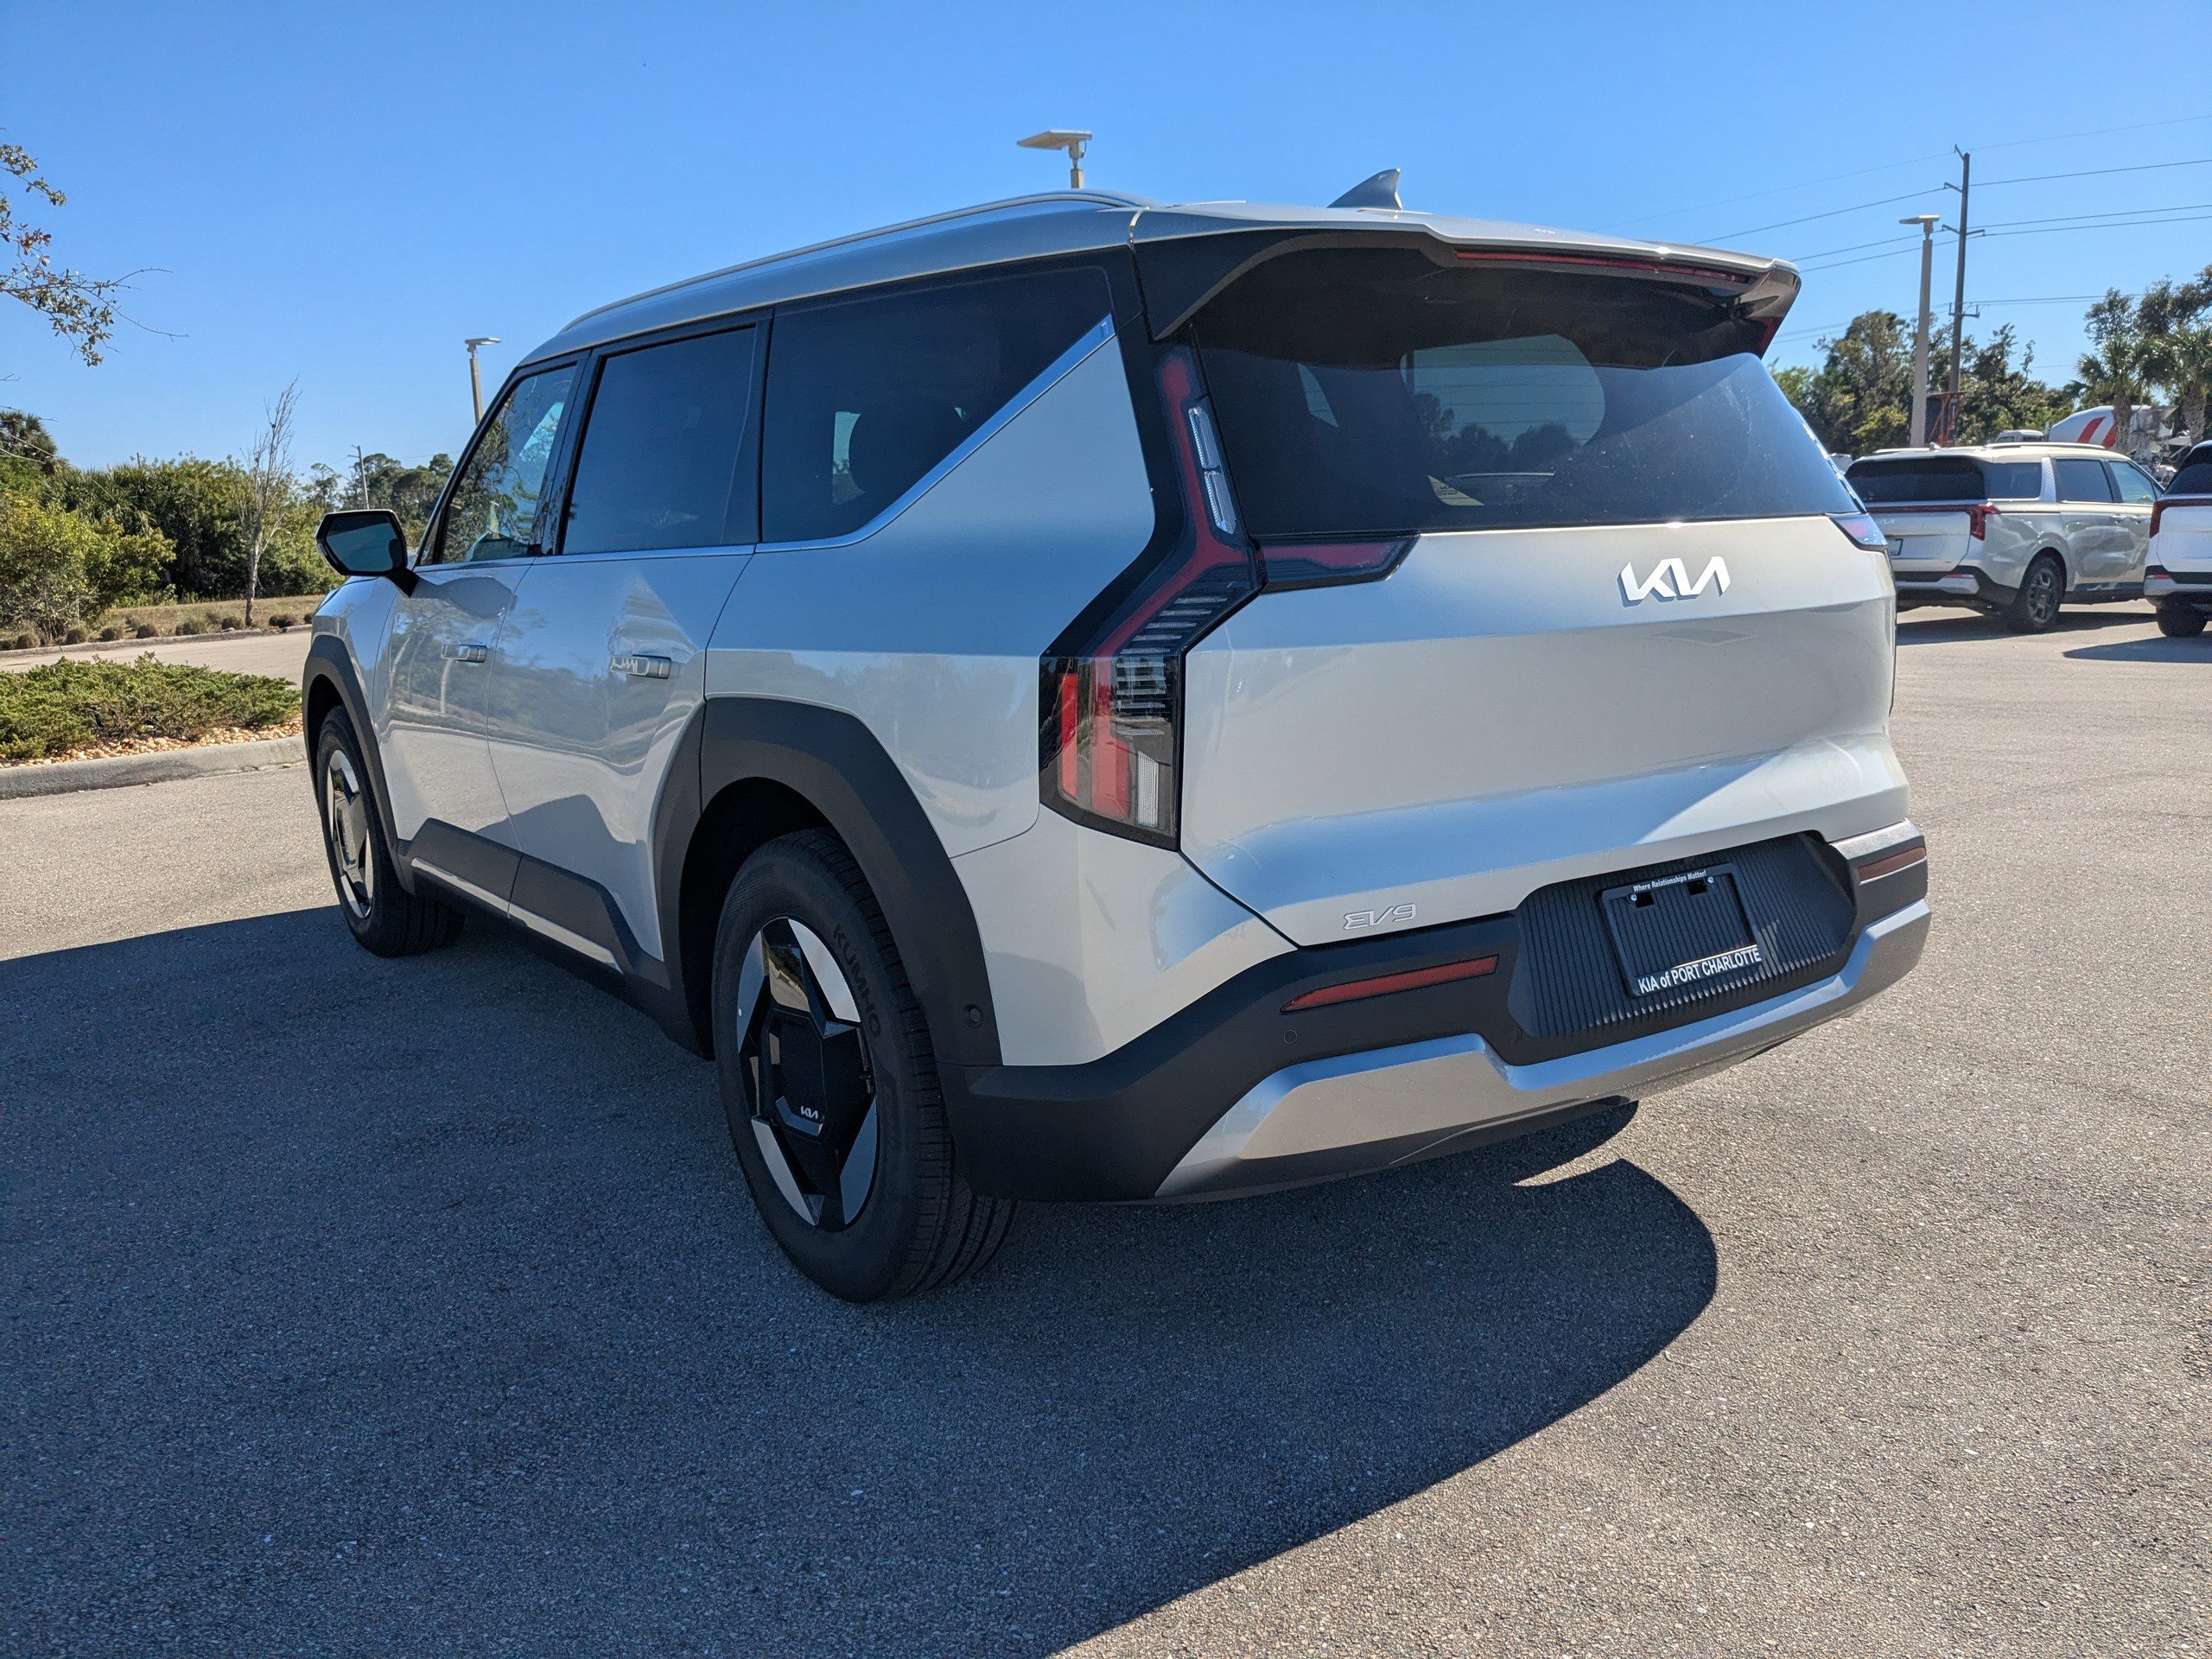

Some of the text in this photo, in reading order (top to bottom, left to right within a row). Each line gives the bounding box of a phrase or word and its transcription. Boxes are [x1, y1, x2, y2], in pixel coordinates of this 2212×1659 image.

[1618, 556, 1730, 607] KIA
[1633, 870, 1707, 893] Where Relationships Matter!
[1344, 903, 1416, 931] EV9
[833, 923, 881, 1039] KUMHO
[1637, 948, 1762, 994] KIA of PORT CHARLOTTE
[800, 1105, 819, 1120] KIA
